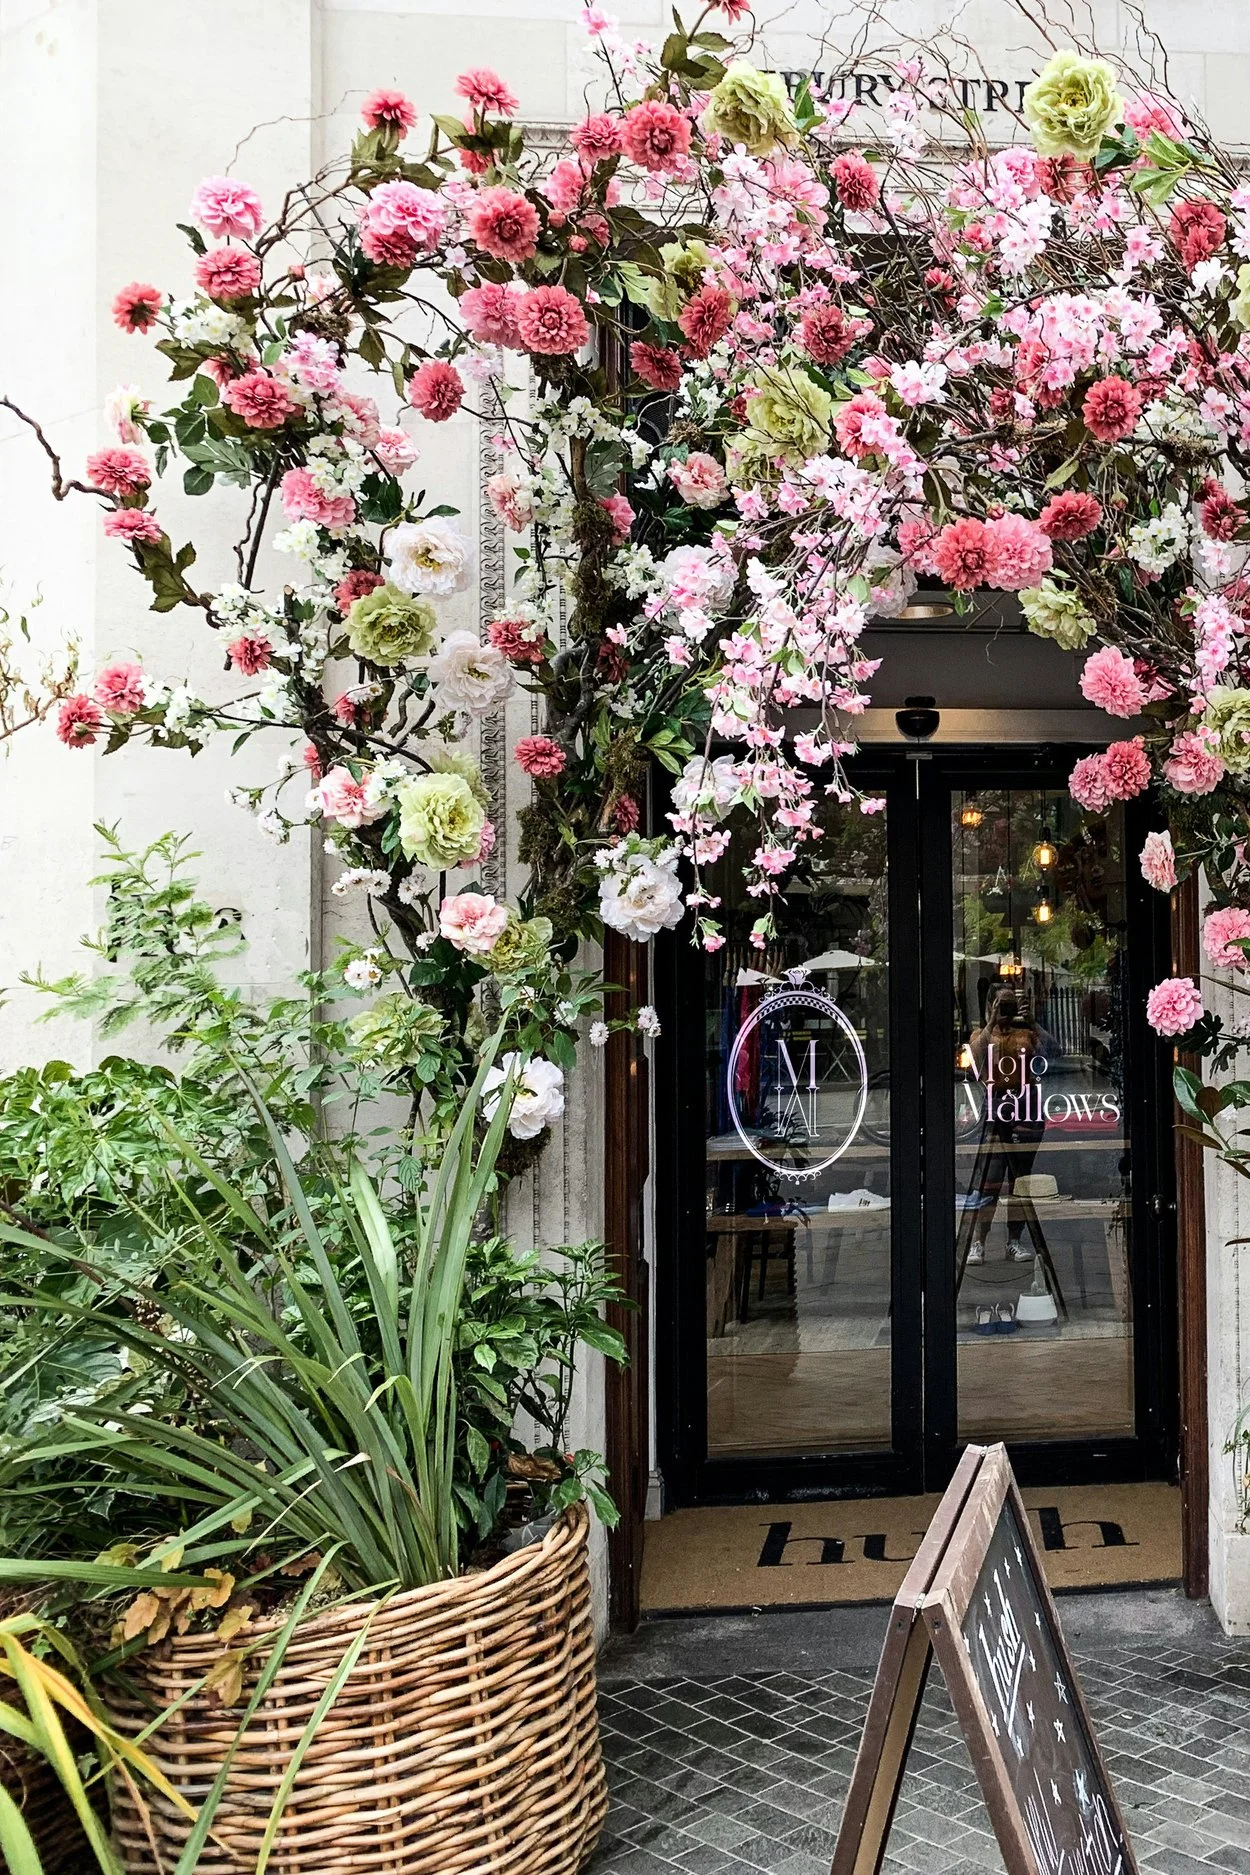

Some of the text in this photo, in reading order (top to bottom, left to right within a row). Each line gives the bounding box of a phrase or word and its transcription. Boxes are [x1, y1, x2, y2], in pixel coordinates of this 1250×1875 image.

[961, 1043, 1048, 1099] Mojo
[961, 1083, 1120, 1122] Mallows
[757, 1507, 1140, 1567] huh
